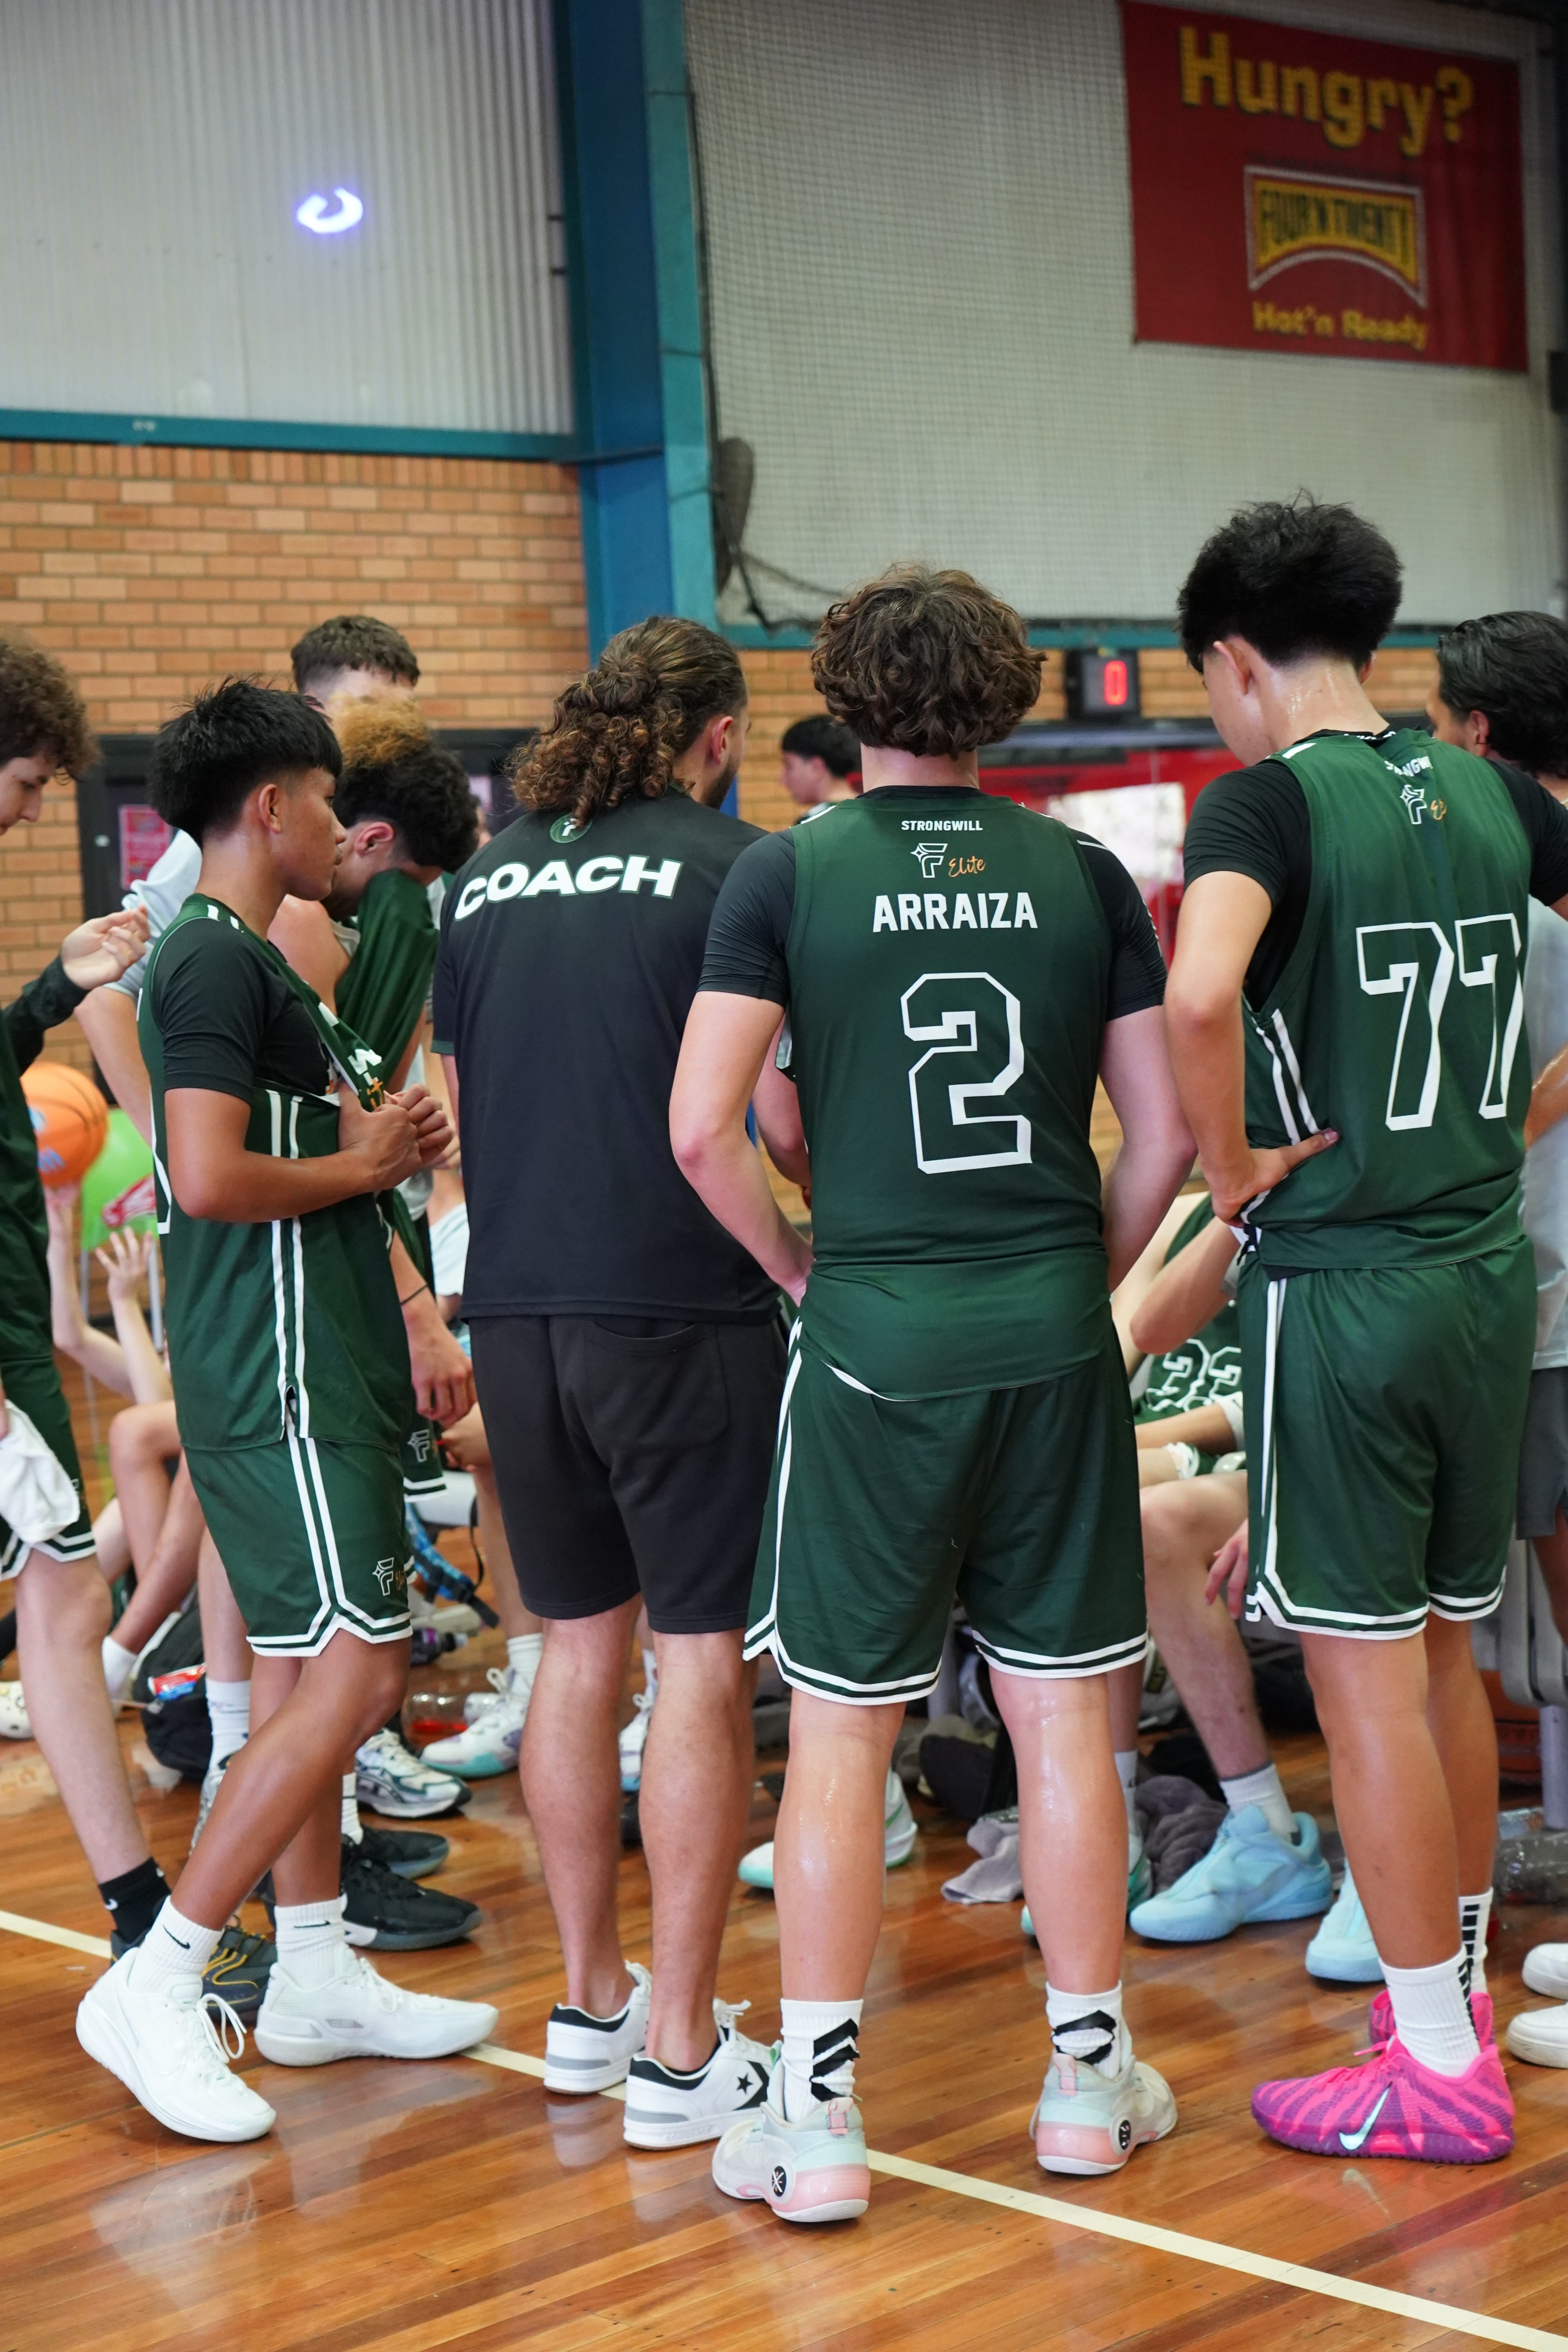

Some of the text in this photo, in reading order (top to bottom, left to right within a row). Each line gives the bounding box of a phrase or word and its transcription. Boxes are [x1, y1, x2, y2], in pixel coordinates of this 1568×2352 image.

[1179, 26, 1474, 157] Hungry?
[1341, 308, 1427, 351] Ready
[901, 820, 983, 831] STRONGWILL
[454, 854, 683, 922] COACH
[948, 855, 986, 877] Elite
[873, 892, 1038, 933] ARRAIZA
[1356, 913, 1524, 1131] 77
[900, 972, 1033, 1174] 2
